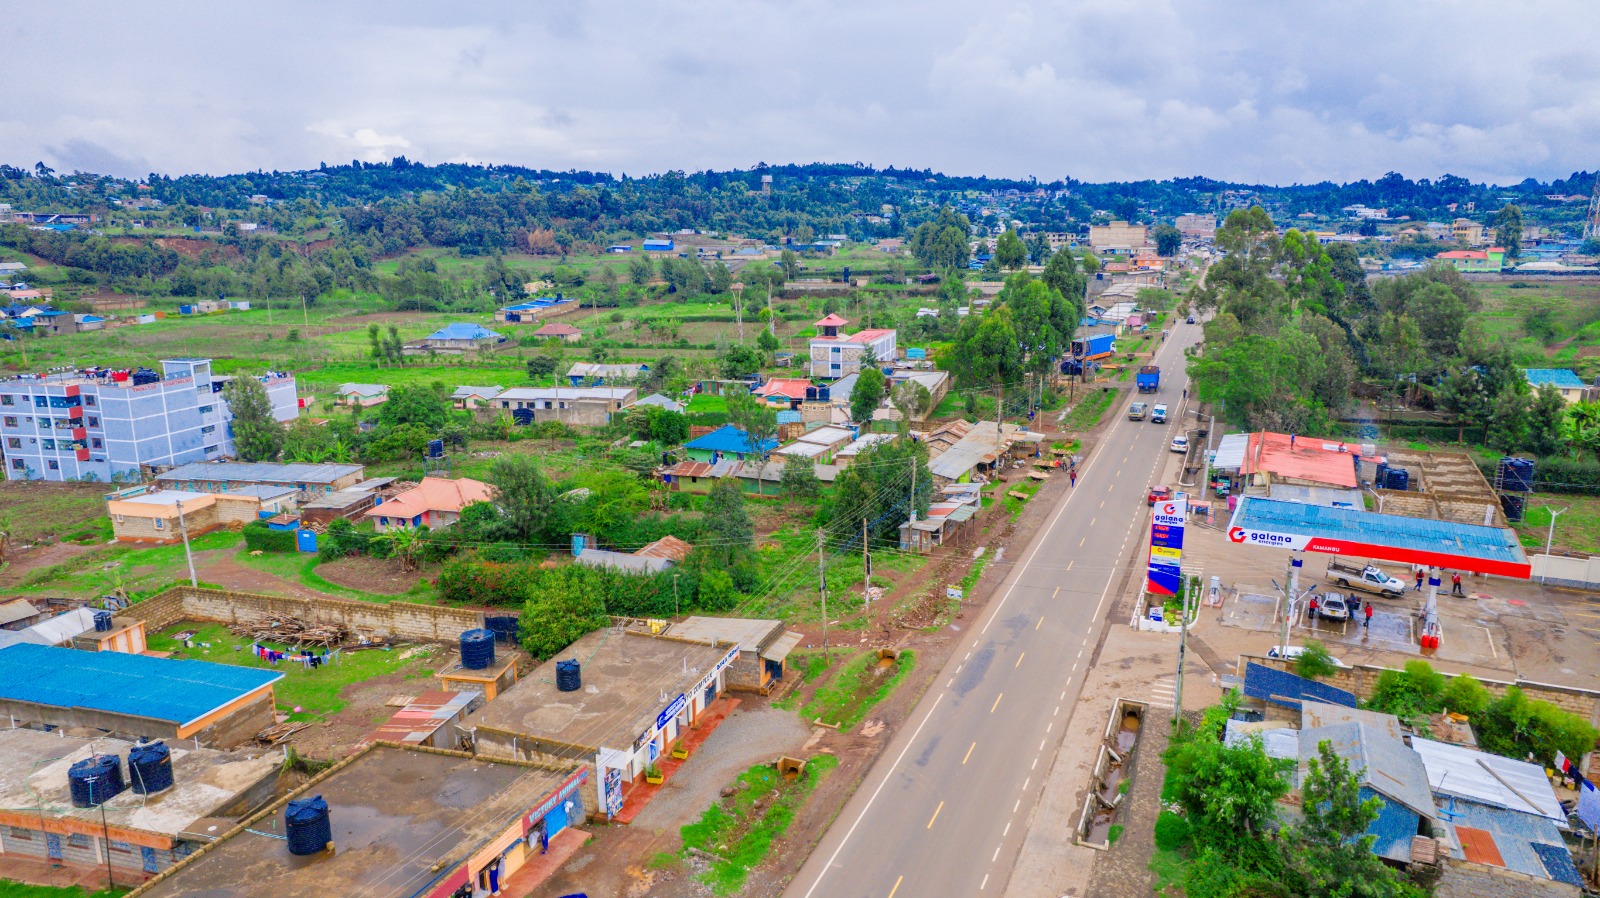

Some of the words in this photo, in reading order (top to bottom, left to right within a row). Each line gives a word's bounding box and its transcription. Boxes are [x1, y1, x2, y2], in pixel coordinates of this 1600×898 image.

[1155, 515, 1183, 523] galana
[1251, 532, 1292, 543] galana
[529, 794, 557, 823] VICTORY
[559, 776, 580, 800] ANIMAL
